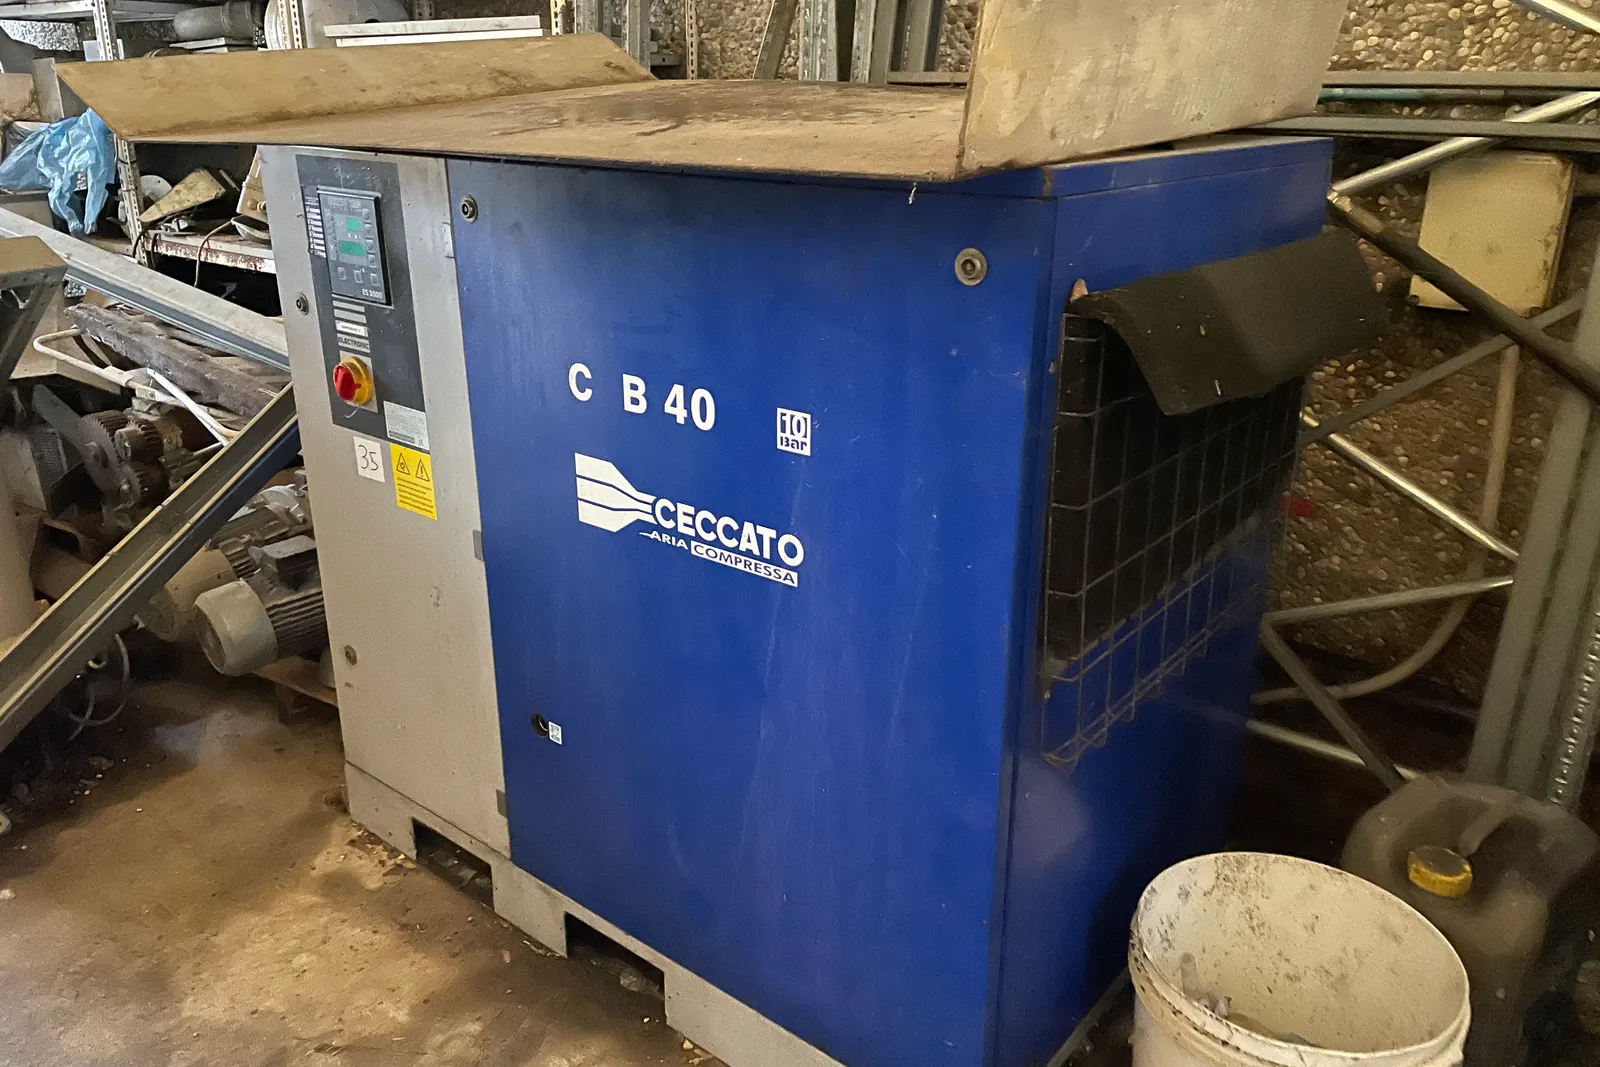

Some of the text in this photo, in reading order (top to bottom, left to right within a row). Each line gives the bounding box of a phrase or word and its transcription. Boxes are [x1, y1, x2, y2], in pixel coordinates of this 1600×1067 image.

[368, 289, 383, 299] 3000
[337, 336, 370, 350] ELECTRONIC
[568, 362, 716, 431] C B 40
[780, 411, 808, 439] 10
[357, 444, 379, 471] 35
[654, 498, 805, 567] CECCATO
[649, 529, 796, 585] ARIA COMPRESSA
